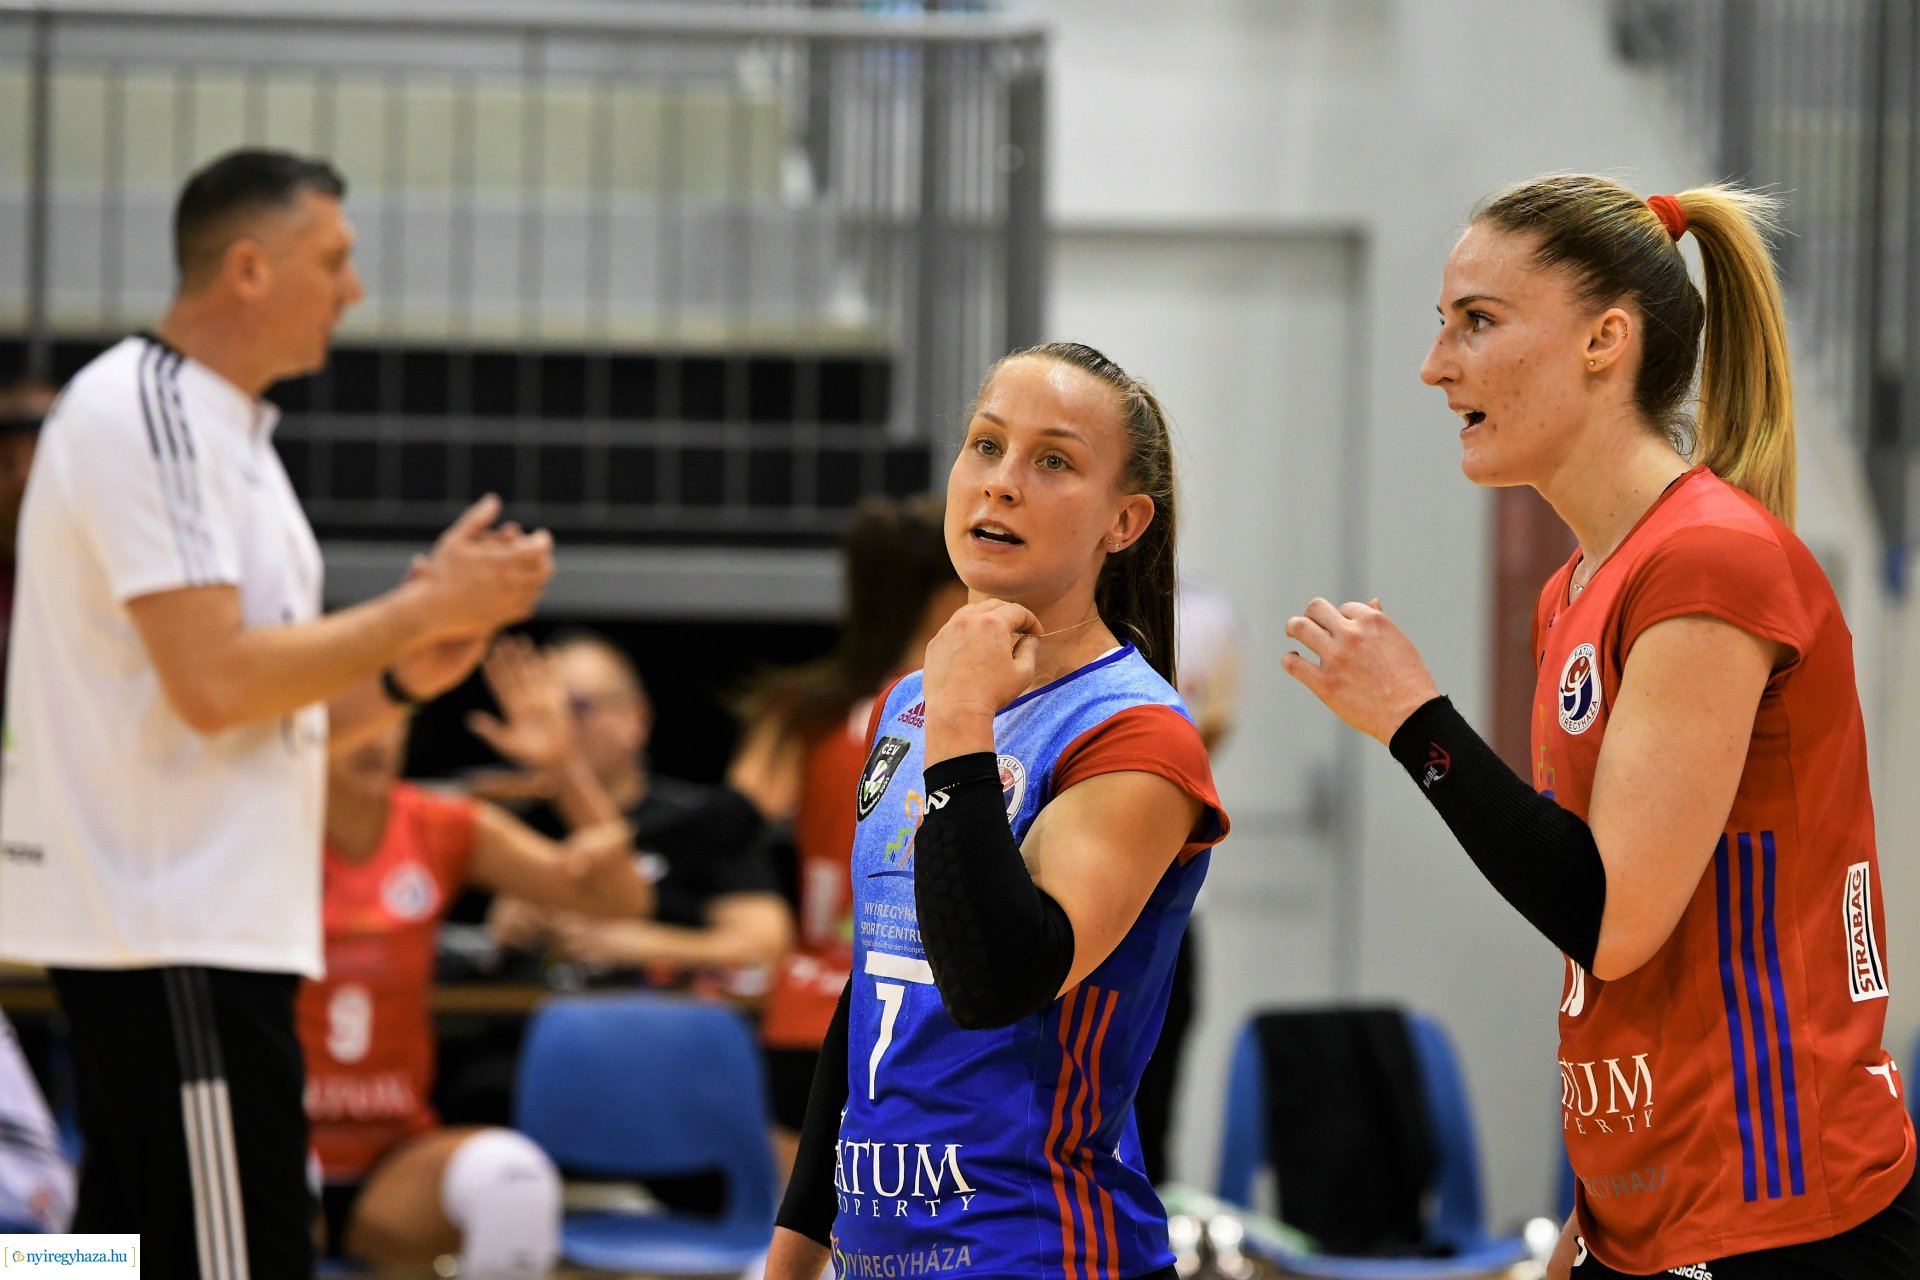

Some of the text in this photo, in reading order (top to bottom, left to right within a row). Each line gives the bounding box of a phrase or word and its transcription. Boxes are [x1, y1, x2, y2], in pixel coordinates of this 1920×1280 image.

[897, 713, 925, 729] adidas
[881, 743, 901, 756] CEV
[997, 758, 1020, 773] ATUM
[864, 901, 917, 922] NYÍREGYHA
[860, 921, 923, 943] SPORTCENTRU
[1851, 869, 1875, 993] STRABAG
[864, 950, 935, 1100] 7
[1563, 1109, 1654, 1136] PERTY
[834, 1135, 976, 1198] ATUM
